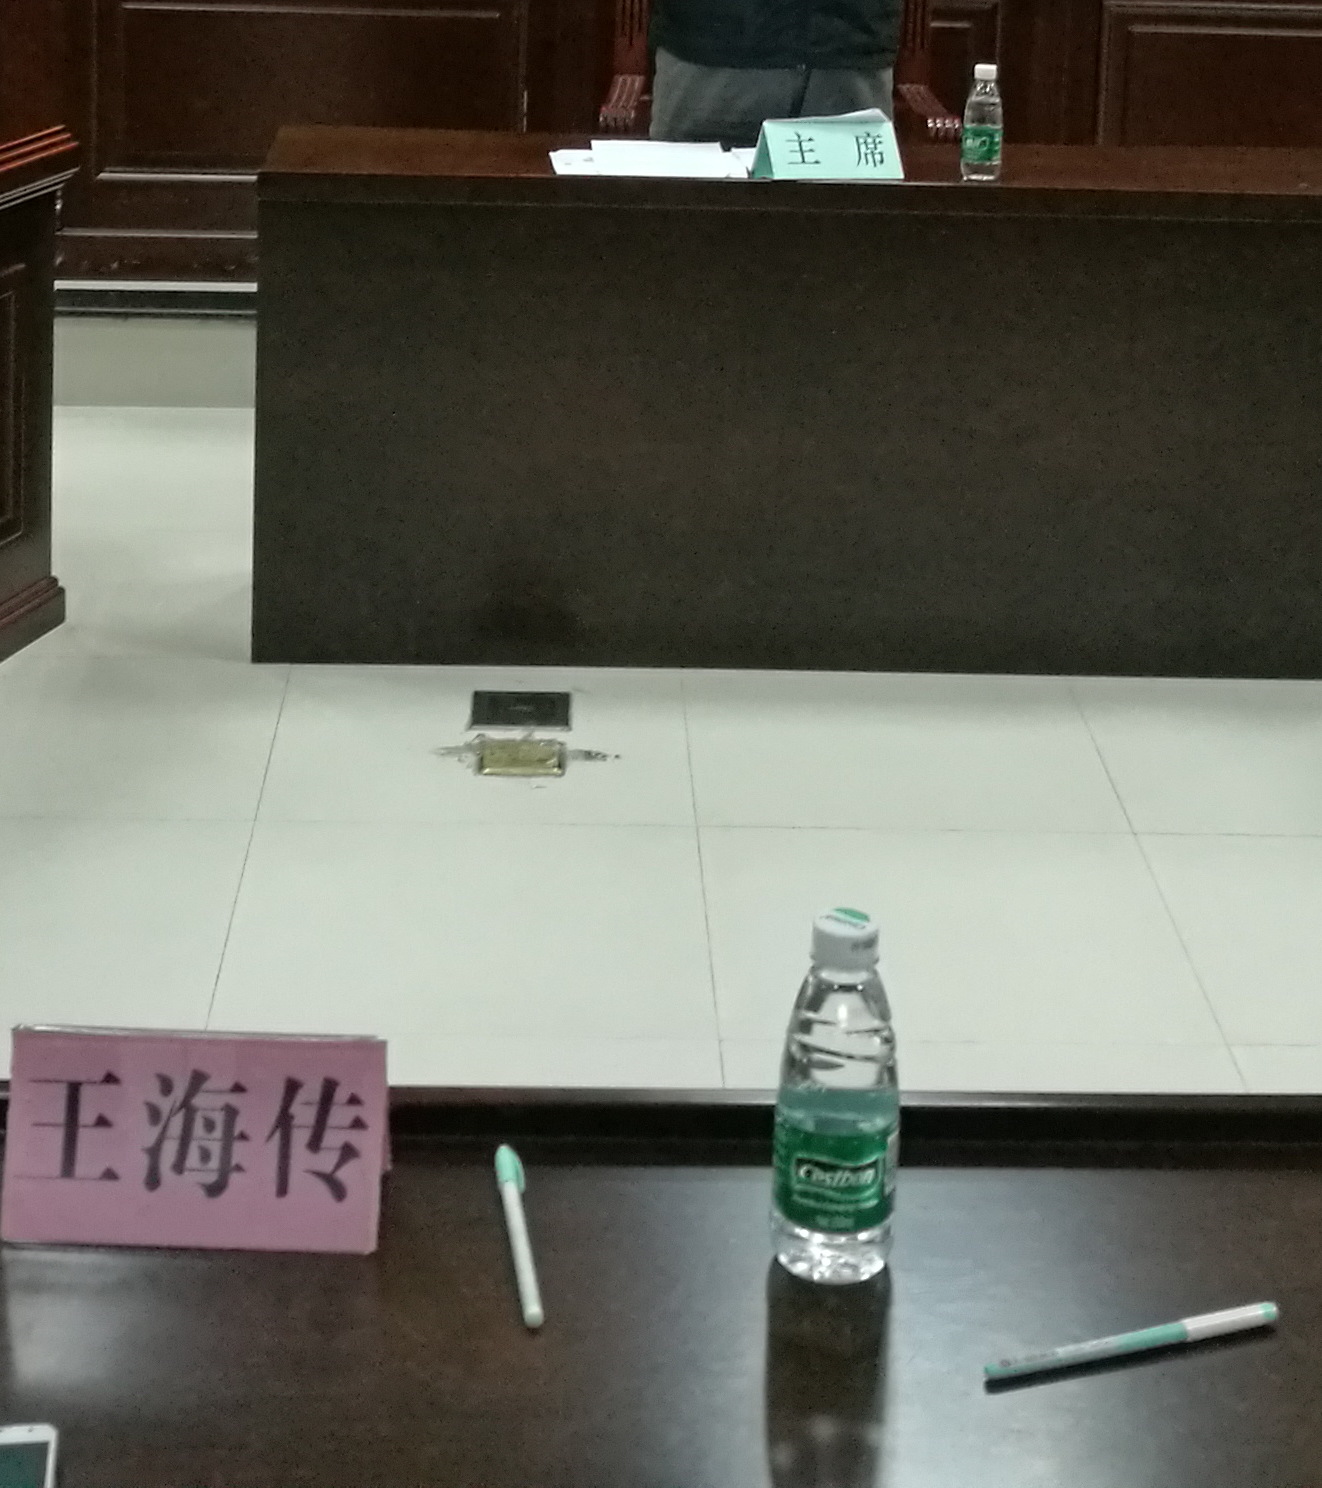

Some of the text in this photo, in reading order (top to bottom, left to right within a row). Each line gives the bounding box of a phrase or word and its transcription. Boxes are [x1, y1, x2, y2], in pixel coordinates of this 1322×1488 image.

[785, 130, 886, 168] 主席
[13, 1068, 370, 1202] 王海传
